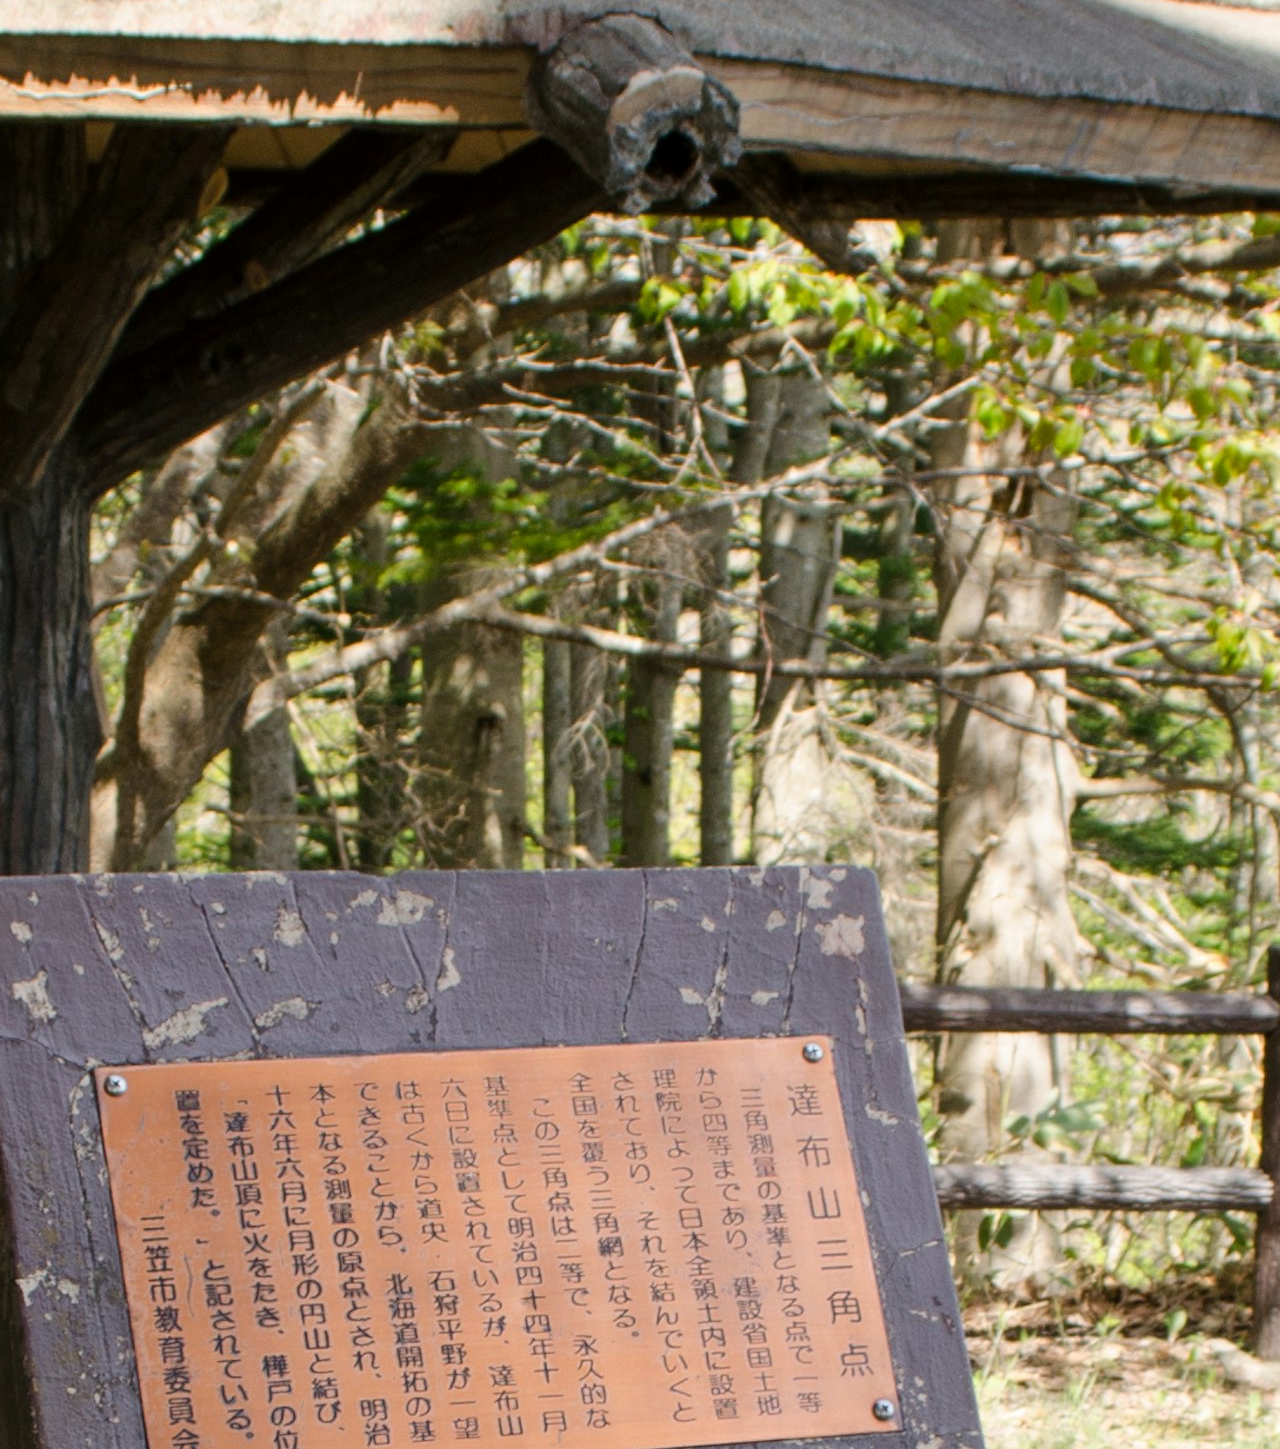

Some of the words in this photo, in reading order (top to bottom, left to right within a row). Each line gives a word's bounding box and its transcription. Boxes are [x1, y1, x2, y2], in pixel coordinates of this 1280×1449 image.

[265, 1085, 345, 1431] 十六年六月に月形の円山と結び、
[309, 1081, 391, 1446] 本となる測量の原点とされ、明治
[440, 1077, 524, 1436] 六日に設置されているが、達布山
[483, 1075, 568, 1433] 基準点として明治四十四年十一月
[532, 1096, 612, 1429] この三角点は二等で、永久的な
[569, 1072, 641, 1339] 全国を覆う三角網となる。
[611, 1071, 697, 1424] されており、それを結んでいくと
[653, 1068, 740, 1421] 理院によって日本全領土内に設置
[694, 1067, 782, 1417] から四等まであり、建設省国土地
[739, 1087, 823, 1414] 三角測量の基準となる点で一等
[786, 1084, 874, 1377] 達布山三角点
